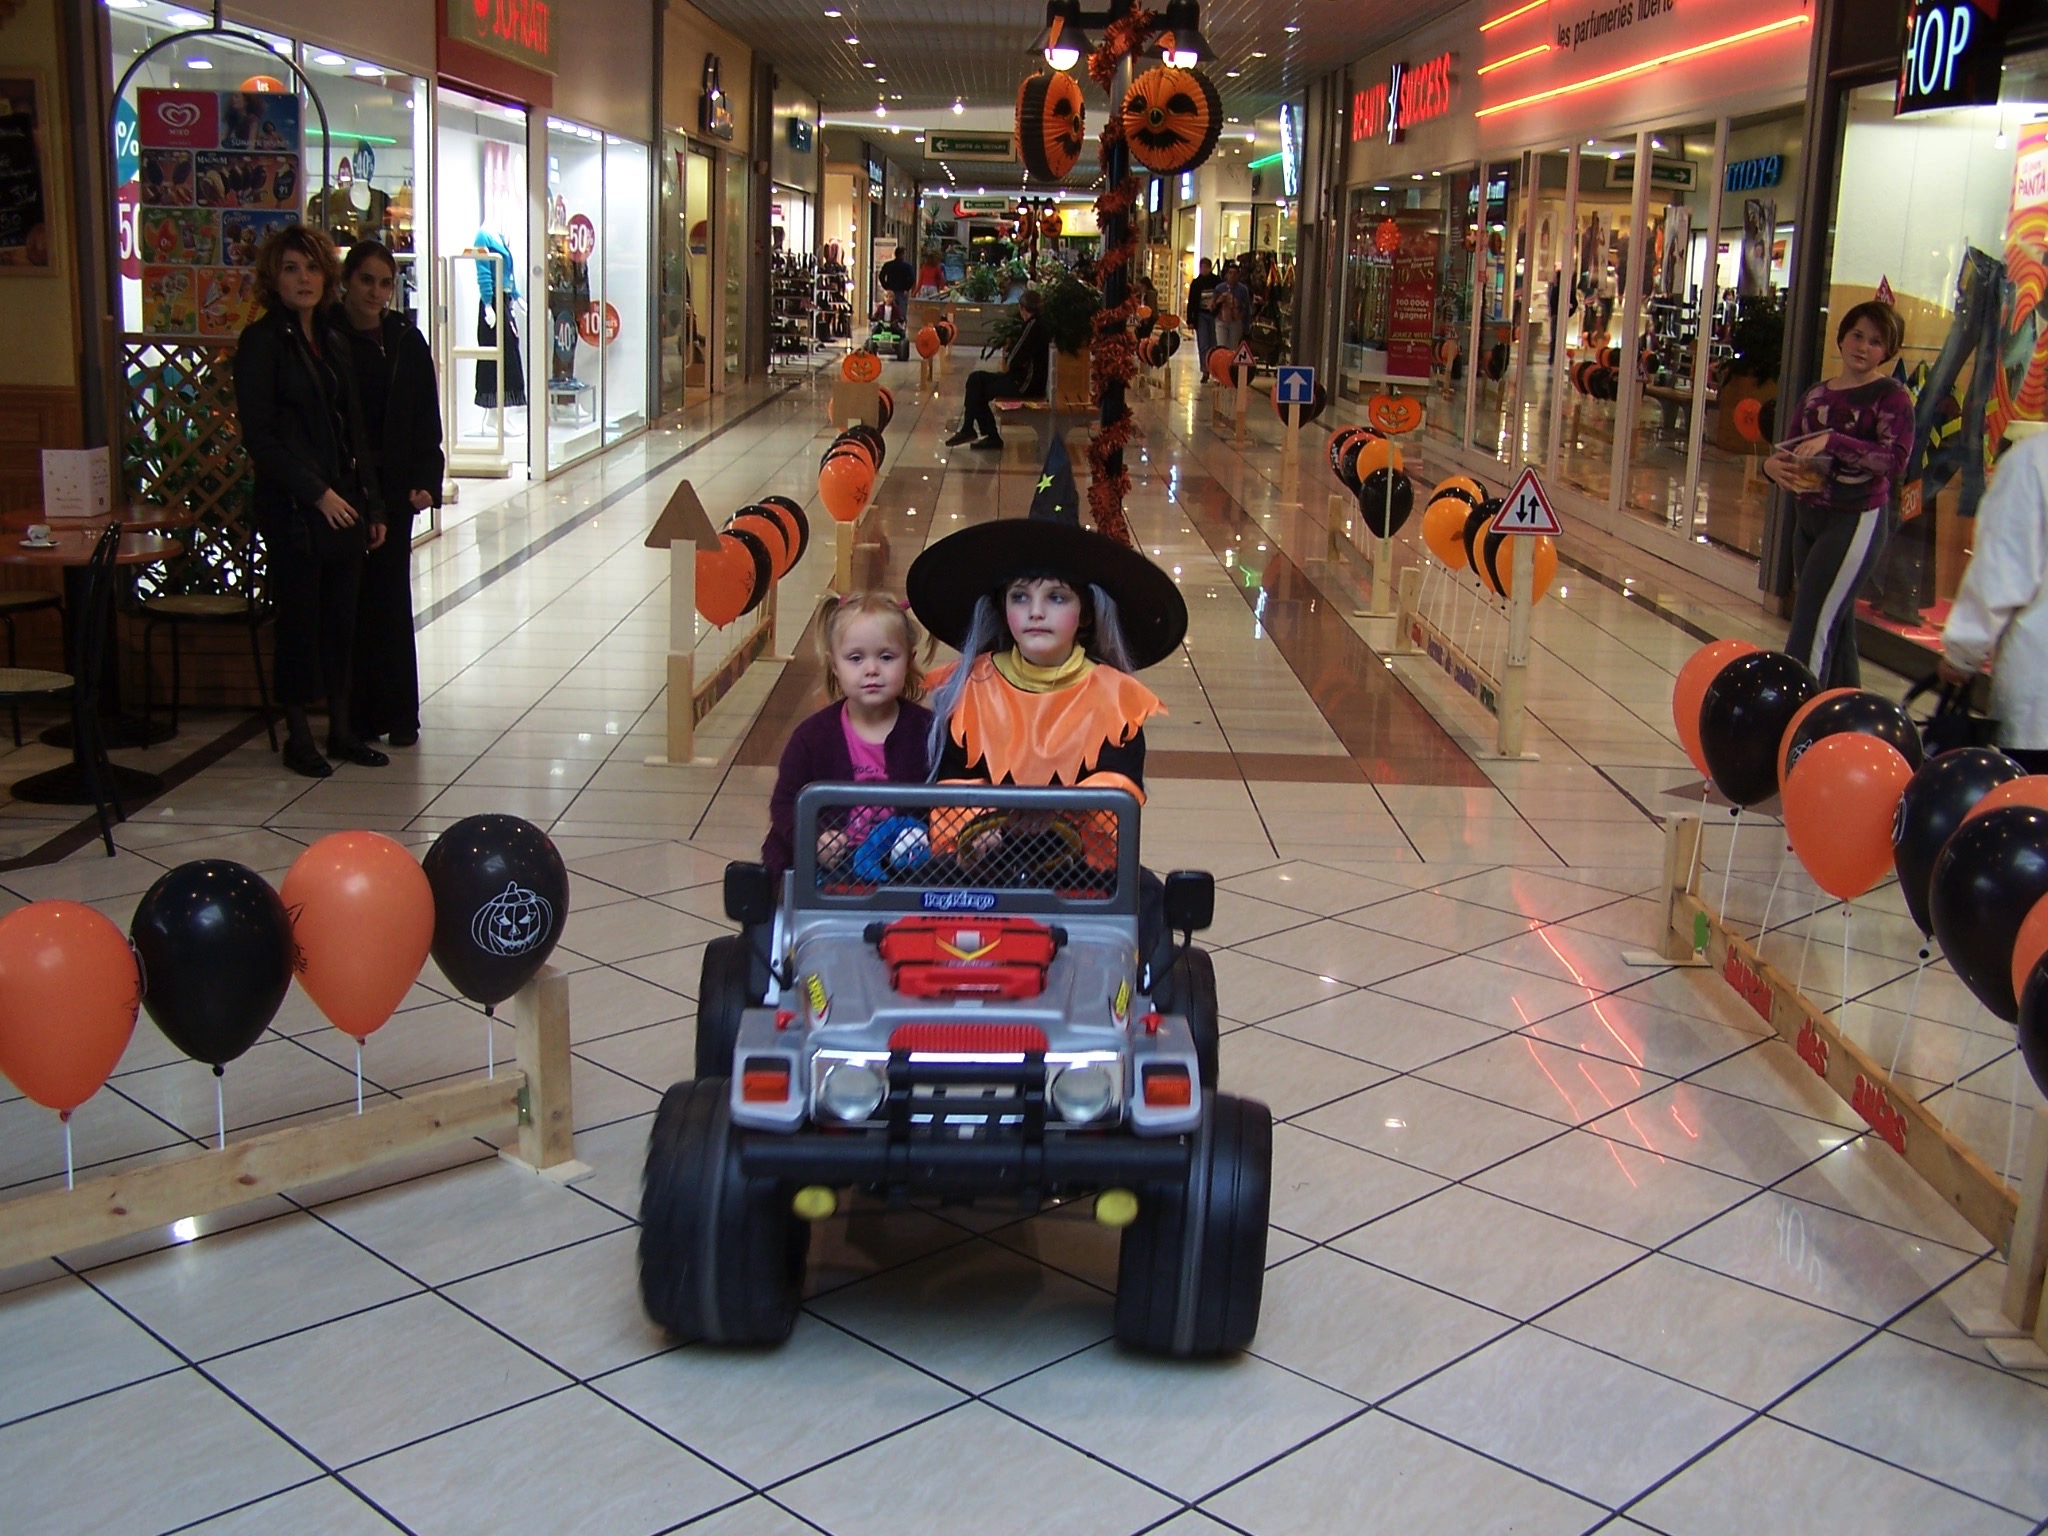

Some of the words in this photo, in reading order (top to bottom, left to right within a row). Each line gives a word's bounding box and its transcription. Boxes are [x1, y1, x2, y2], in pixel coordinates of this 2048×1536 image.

[1557, 24, 1570, 47] les
[1574, 0, 1633, 51] parfumeries
[1352, 82, 1387, 142] BEAUTY
[1399, 51, 1450, 129] SUCCESS
